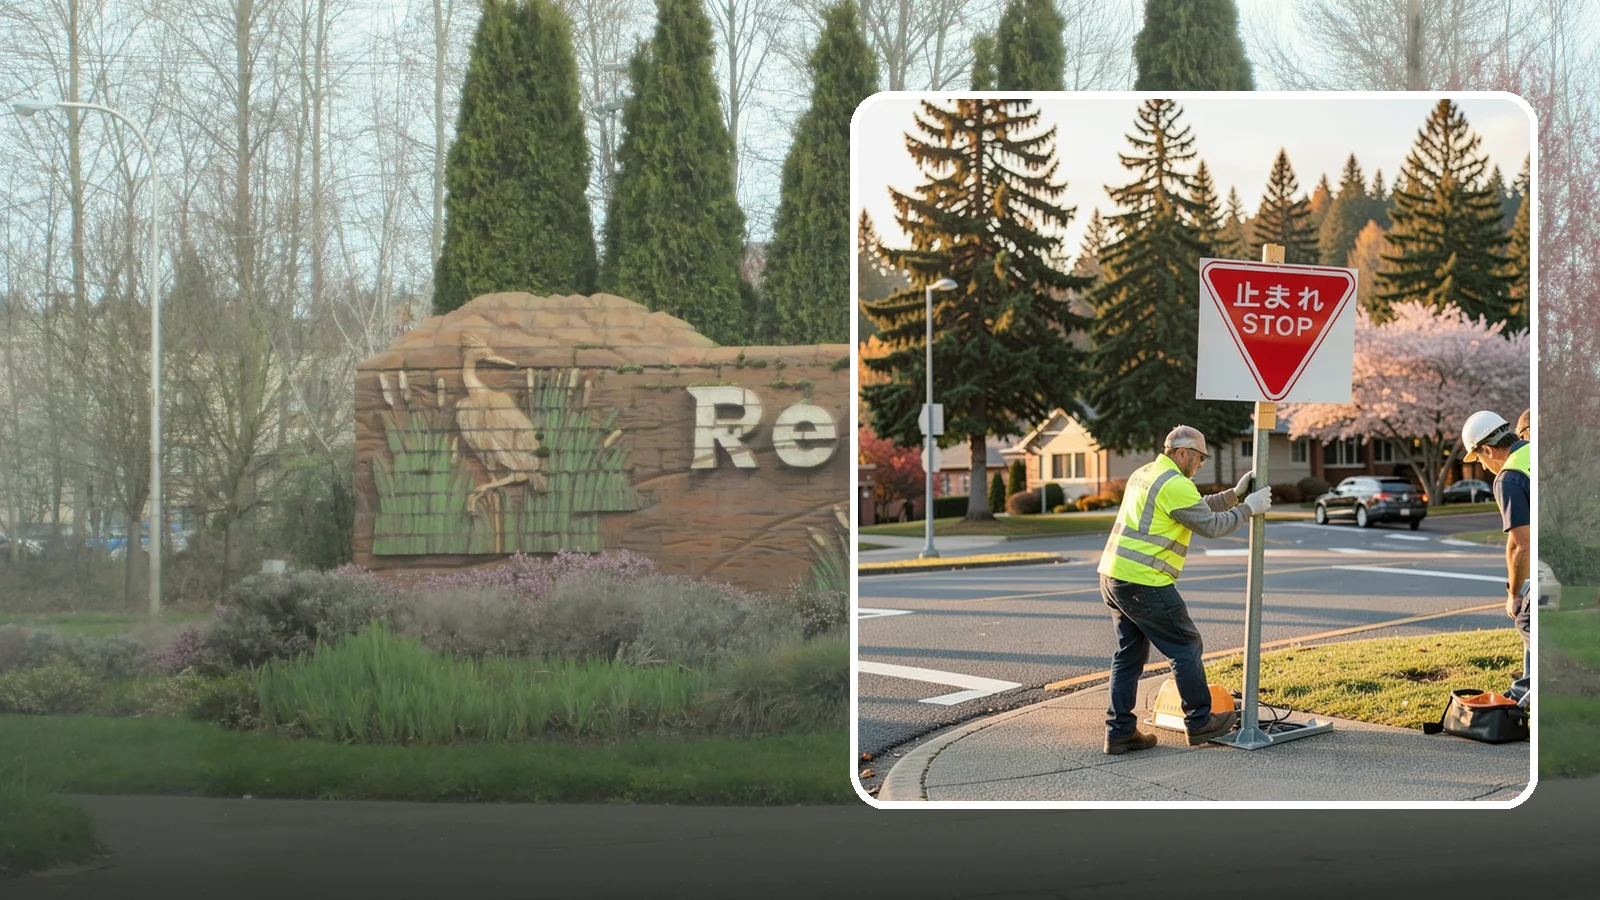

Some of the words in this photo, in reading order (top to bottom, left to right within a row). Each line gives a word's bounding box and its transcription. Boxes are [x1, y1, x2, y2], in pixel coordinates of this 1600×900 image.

[1233, 281, 1324, 312] 止まれ
[1242, 313, 1313, 336] STOP
[686, 386, 838, 469] Re
